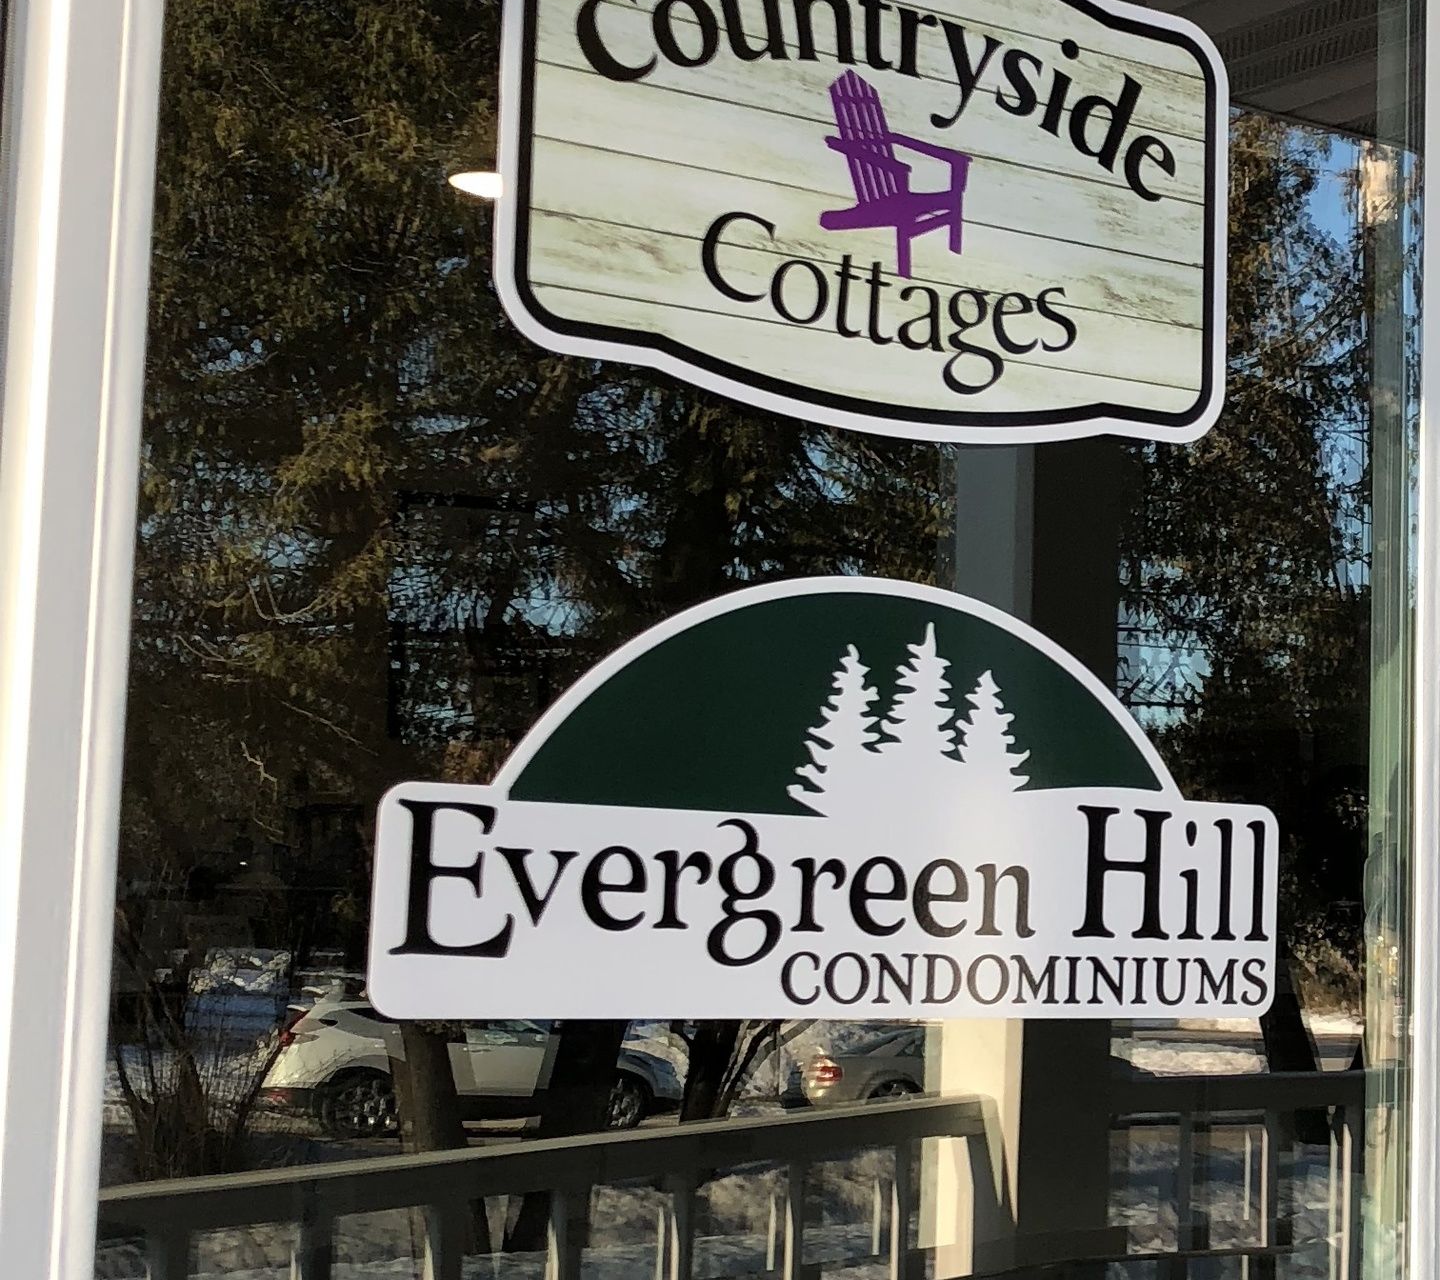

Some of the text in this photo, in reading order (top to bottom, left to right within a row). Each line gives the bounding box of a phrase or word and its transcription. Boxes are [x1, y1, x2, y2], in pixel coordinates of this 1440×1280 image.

[700, 210, 1077, 395] Cottages
[387, 798, 1270, 968] Evergreen Hill
[780, 949, 1269, 1007] CONDOMINIUMS
